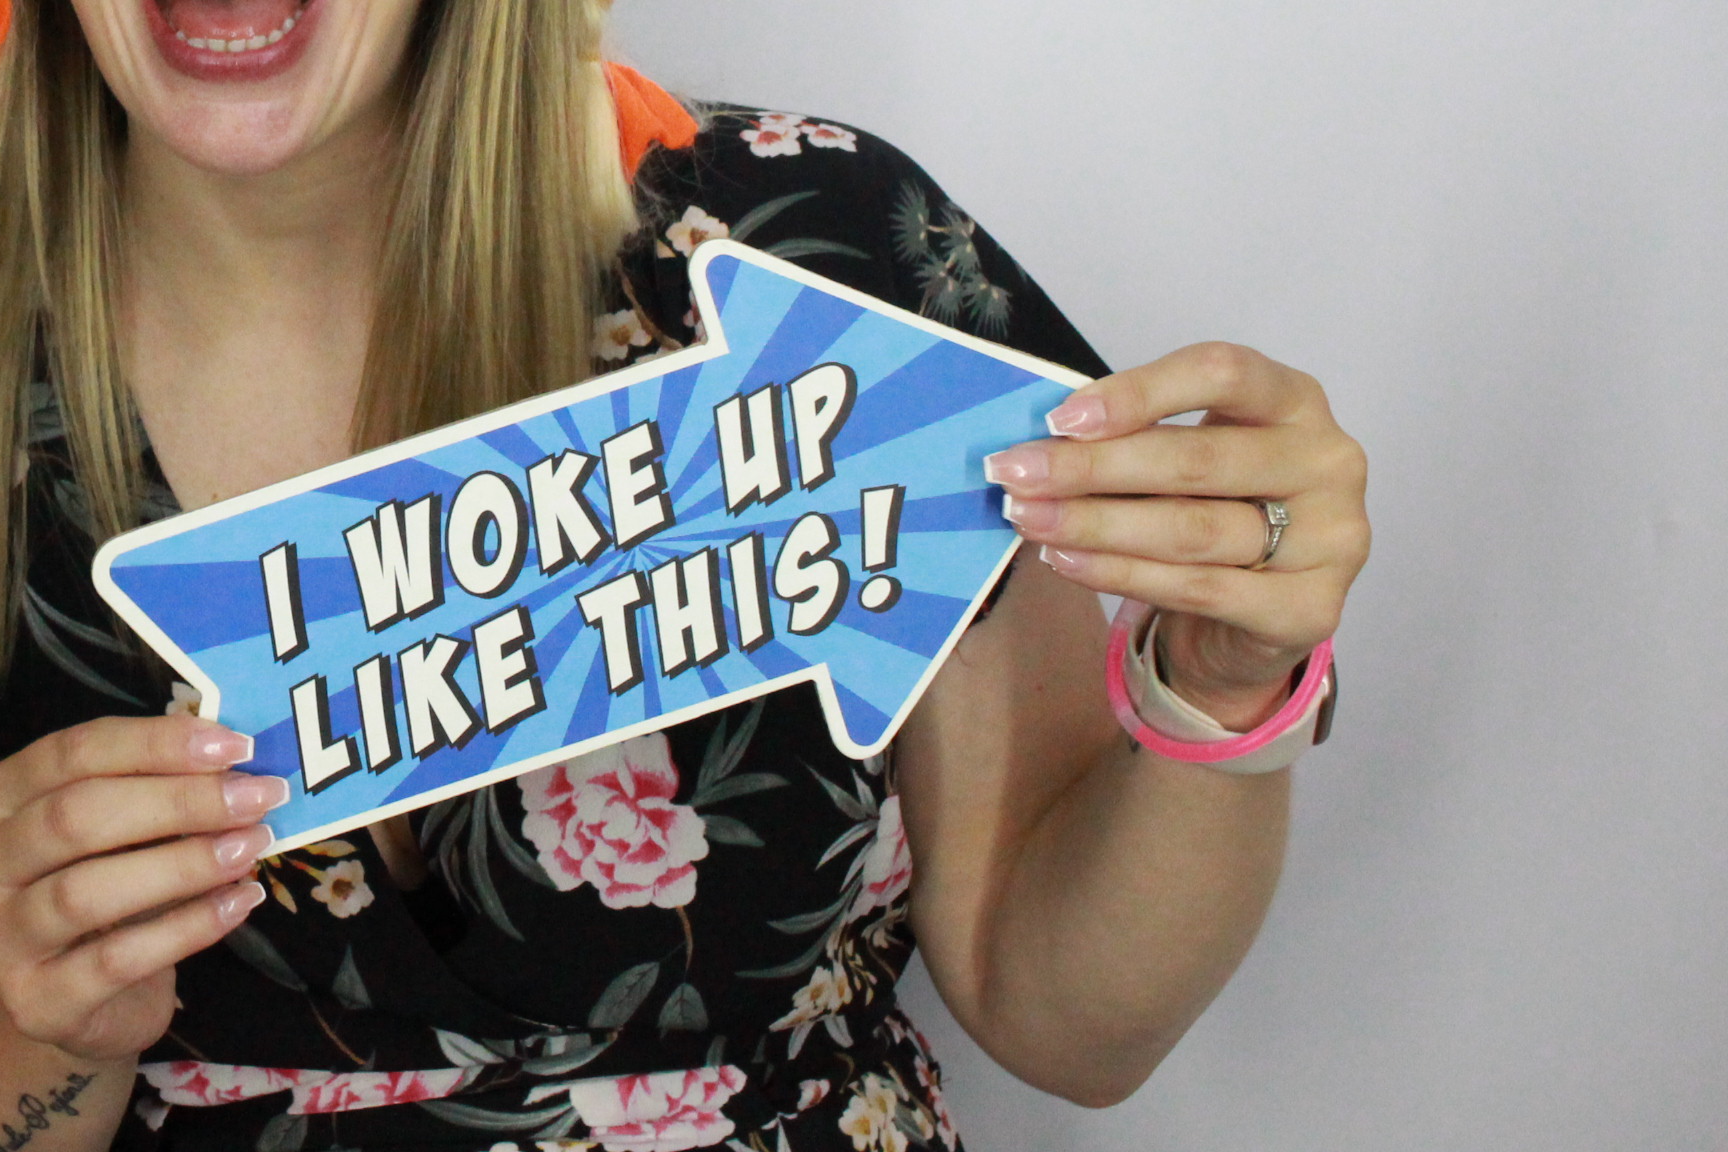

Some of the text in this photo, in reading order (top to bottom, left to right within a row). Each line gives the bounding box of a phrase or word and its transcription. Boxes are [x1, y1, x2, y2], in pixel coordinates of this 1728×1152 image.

[260, 361, 858, 662] I WOKE UP
[290, 484, 906, 796] LIKE THIS!
